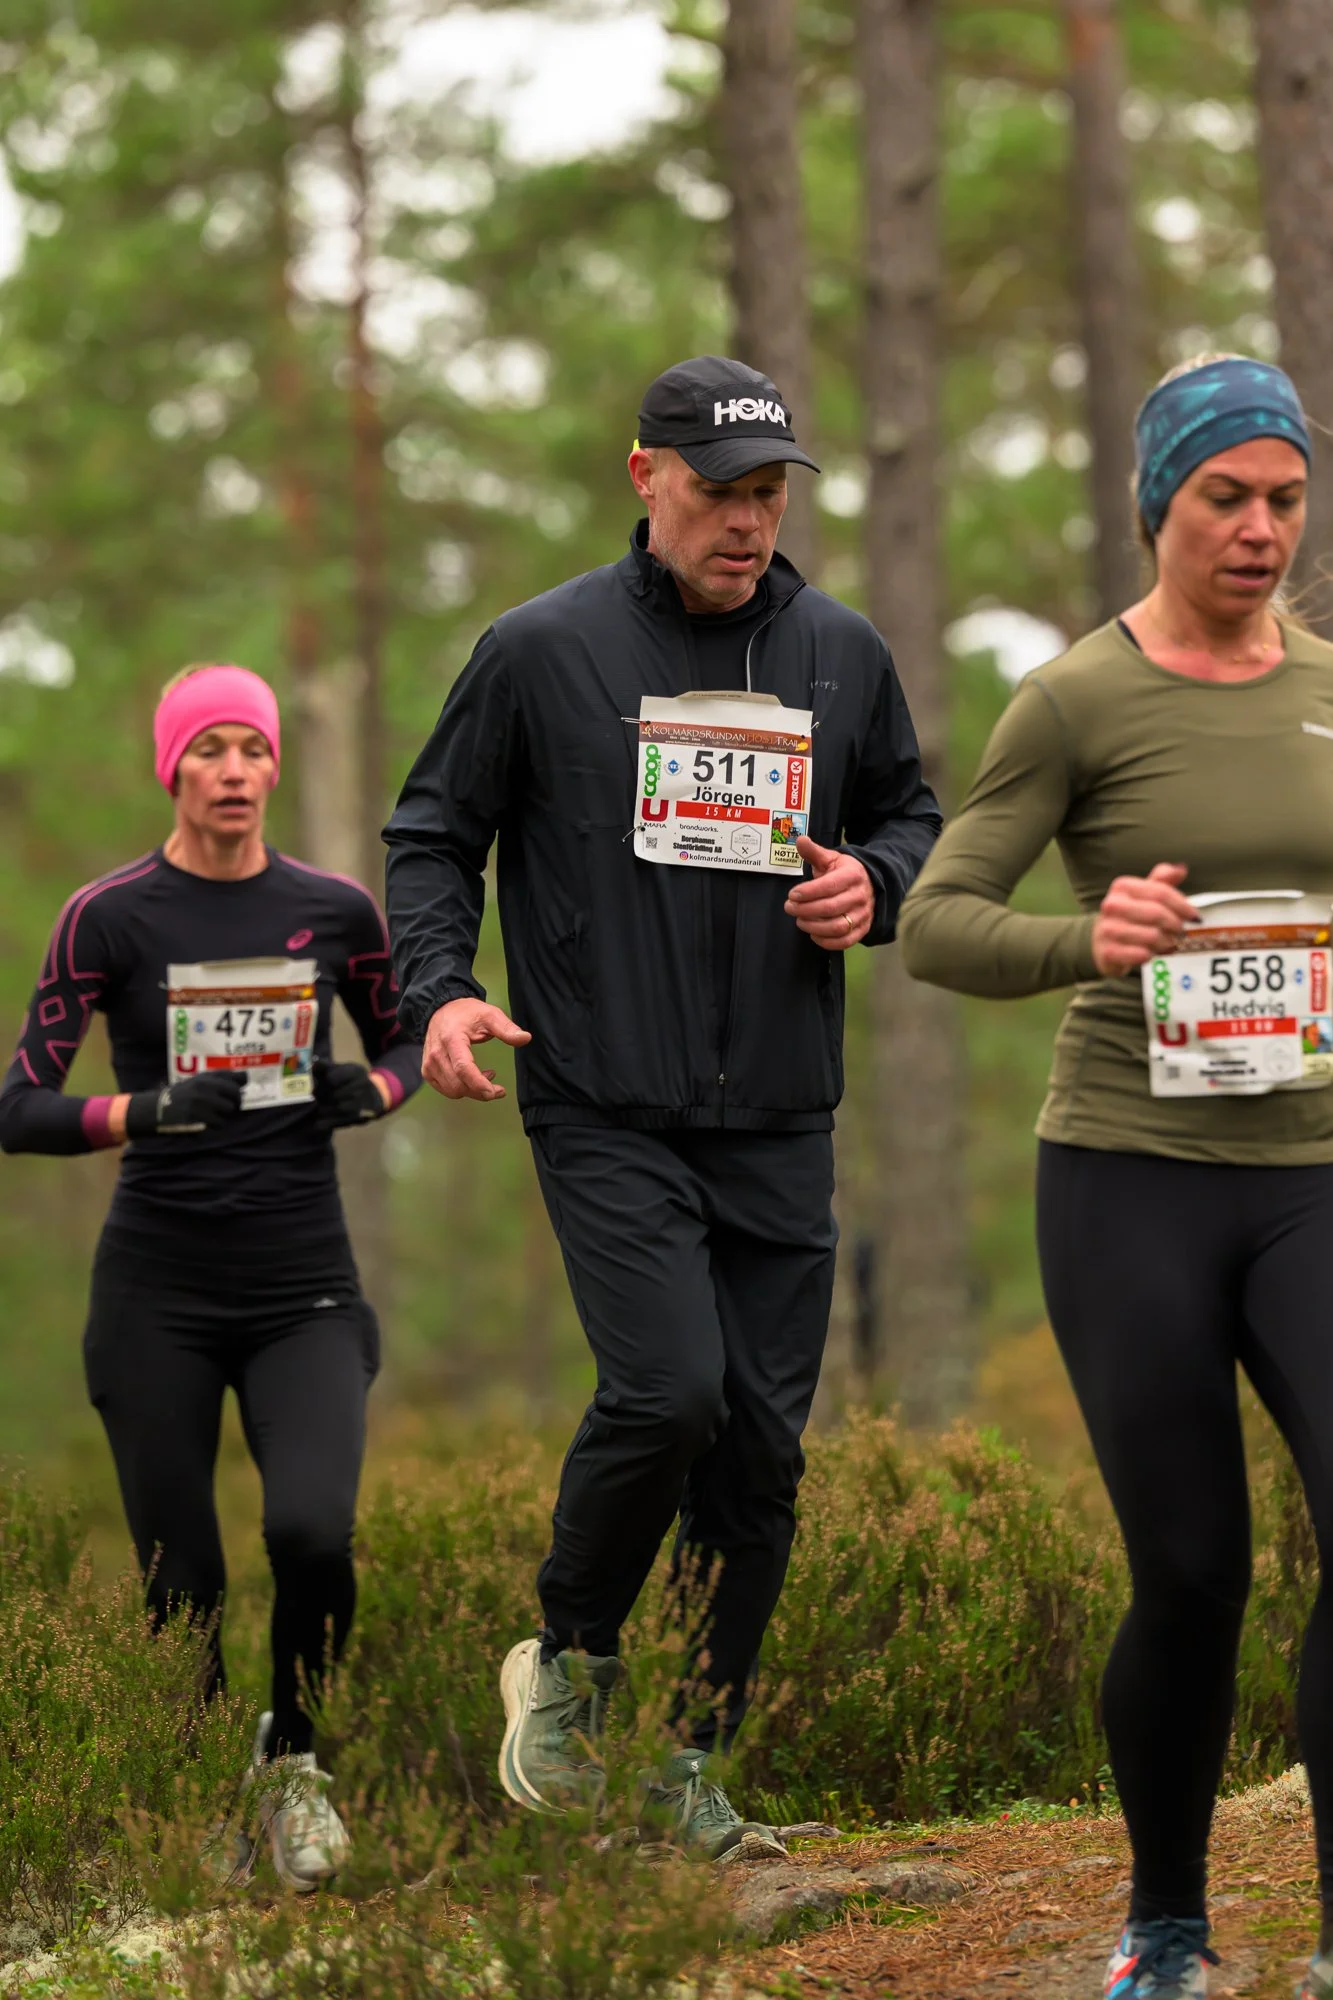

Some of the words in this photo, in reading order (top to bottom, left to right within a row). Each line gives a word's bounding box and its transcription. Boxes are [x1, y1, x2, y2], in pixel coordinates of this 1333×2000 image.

[714, 398, 786, 427] HOKA
[692, 750, 756, 787] 511
[691, 786, 756, 808] Jörgen
[790, 775, 800, 806] CIRCLE
[689, 853, 761, 867] kolmardsrundantrail
[1210, 955, 1285, 993] 558
[215, 1008, 277, 1037] 475
[1212, 1001, 1286, 1019] Hedvig
